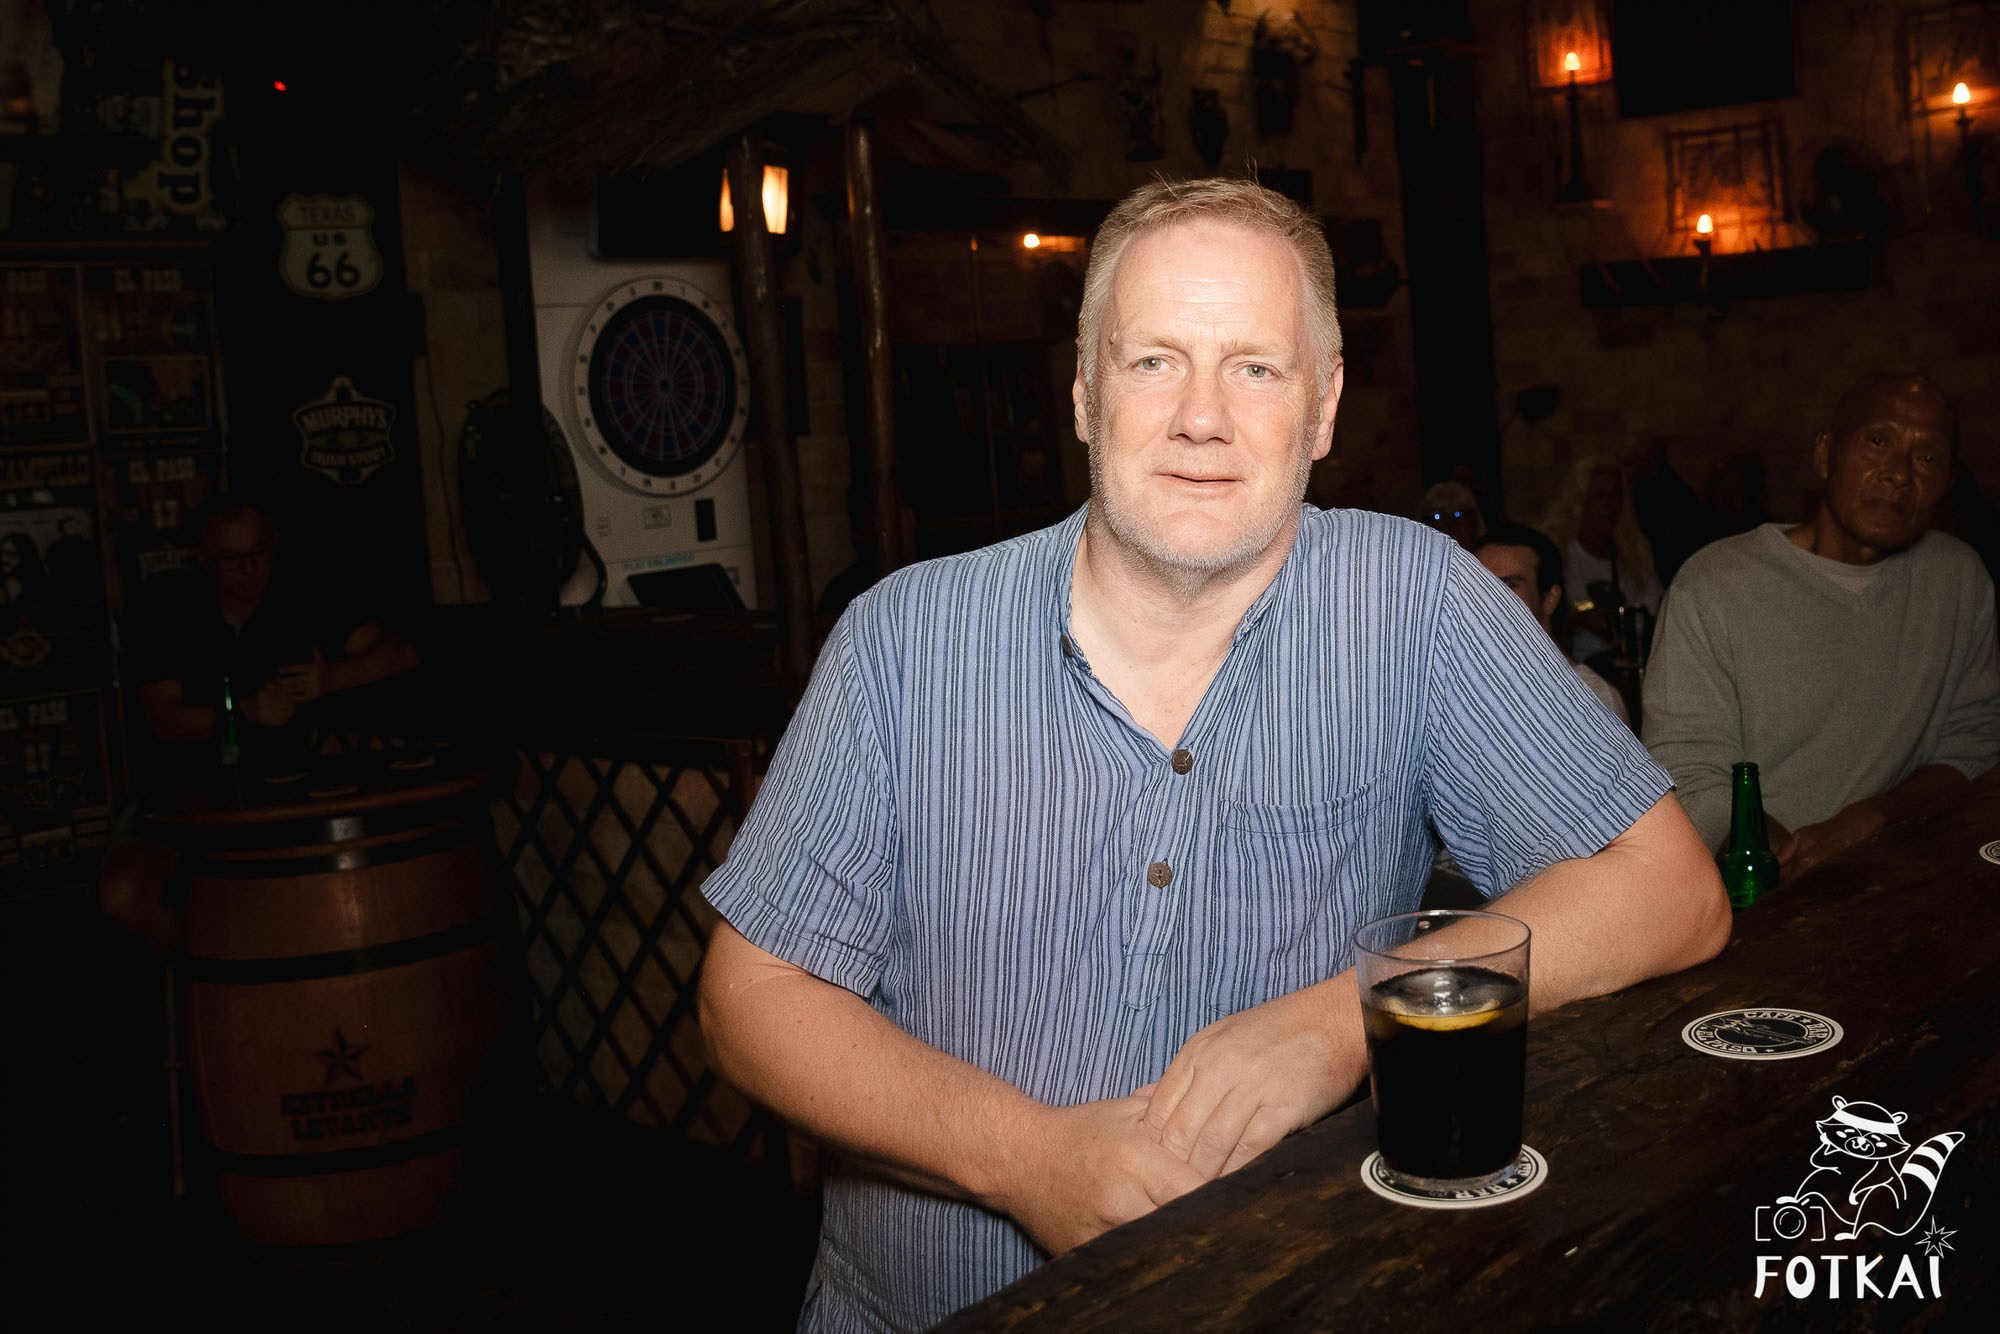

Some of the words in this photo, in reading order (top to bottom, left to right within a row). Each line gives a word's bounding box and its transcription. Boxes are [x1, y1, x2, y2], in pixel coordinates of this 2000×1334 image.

[301, 205, 357, 224] TEXAS
[313, 232, 347, 246] US
[307, 251, 360, 289] 66
[27, 700, 68, 726] PASO
[280, 1075, 418, 1115] ESTRELLA
[290, 1103, 413, 1140] LEVANTE
